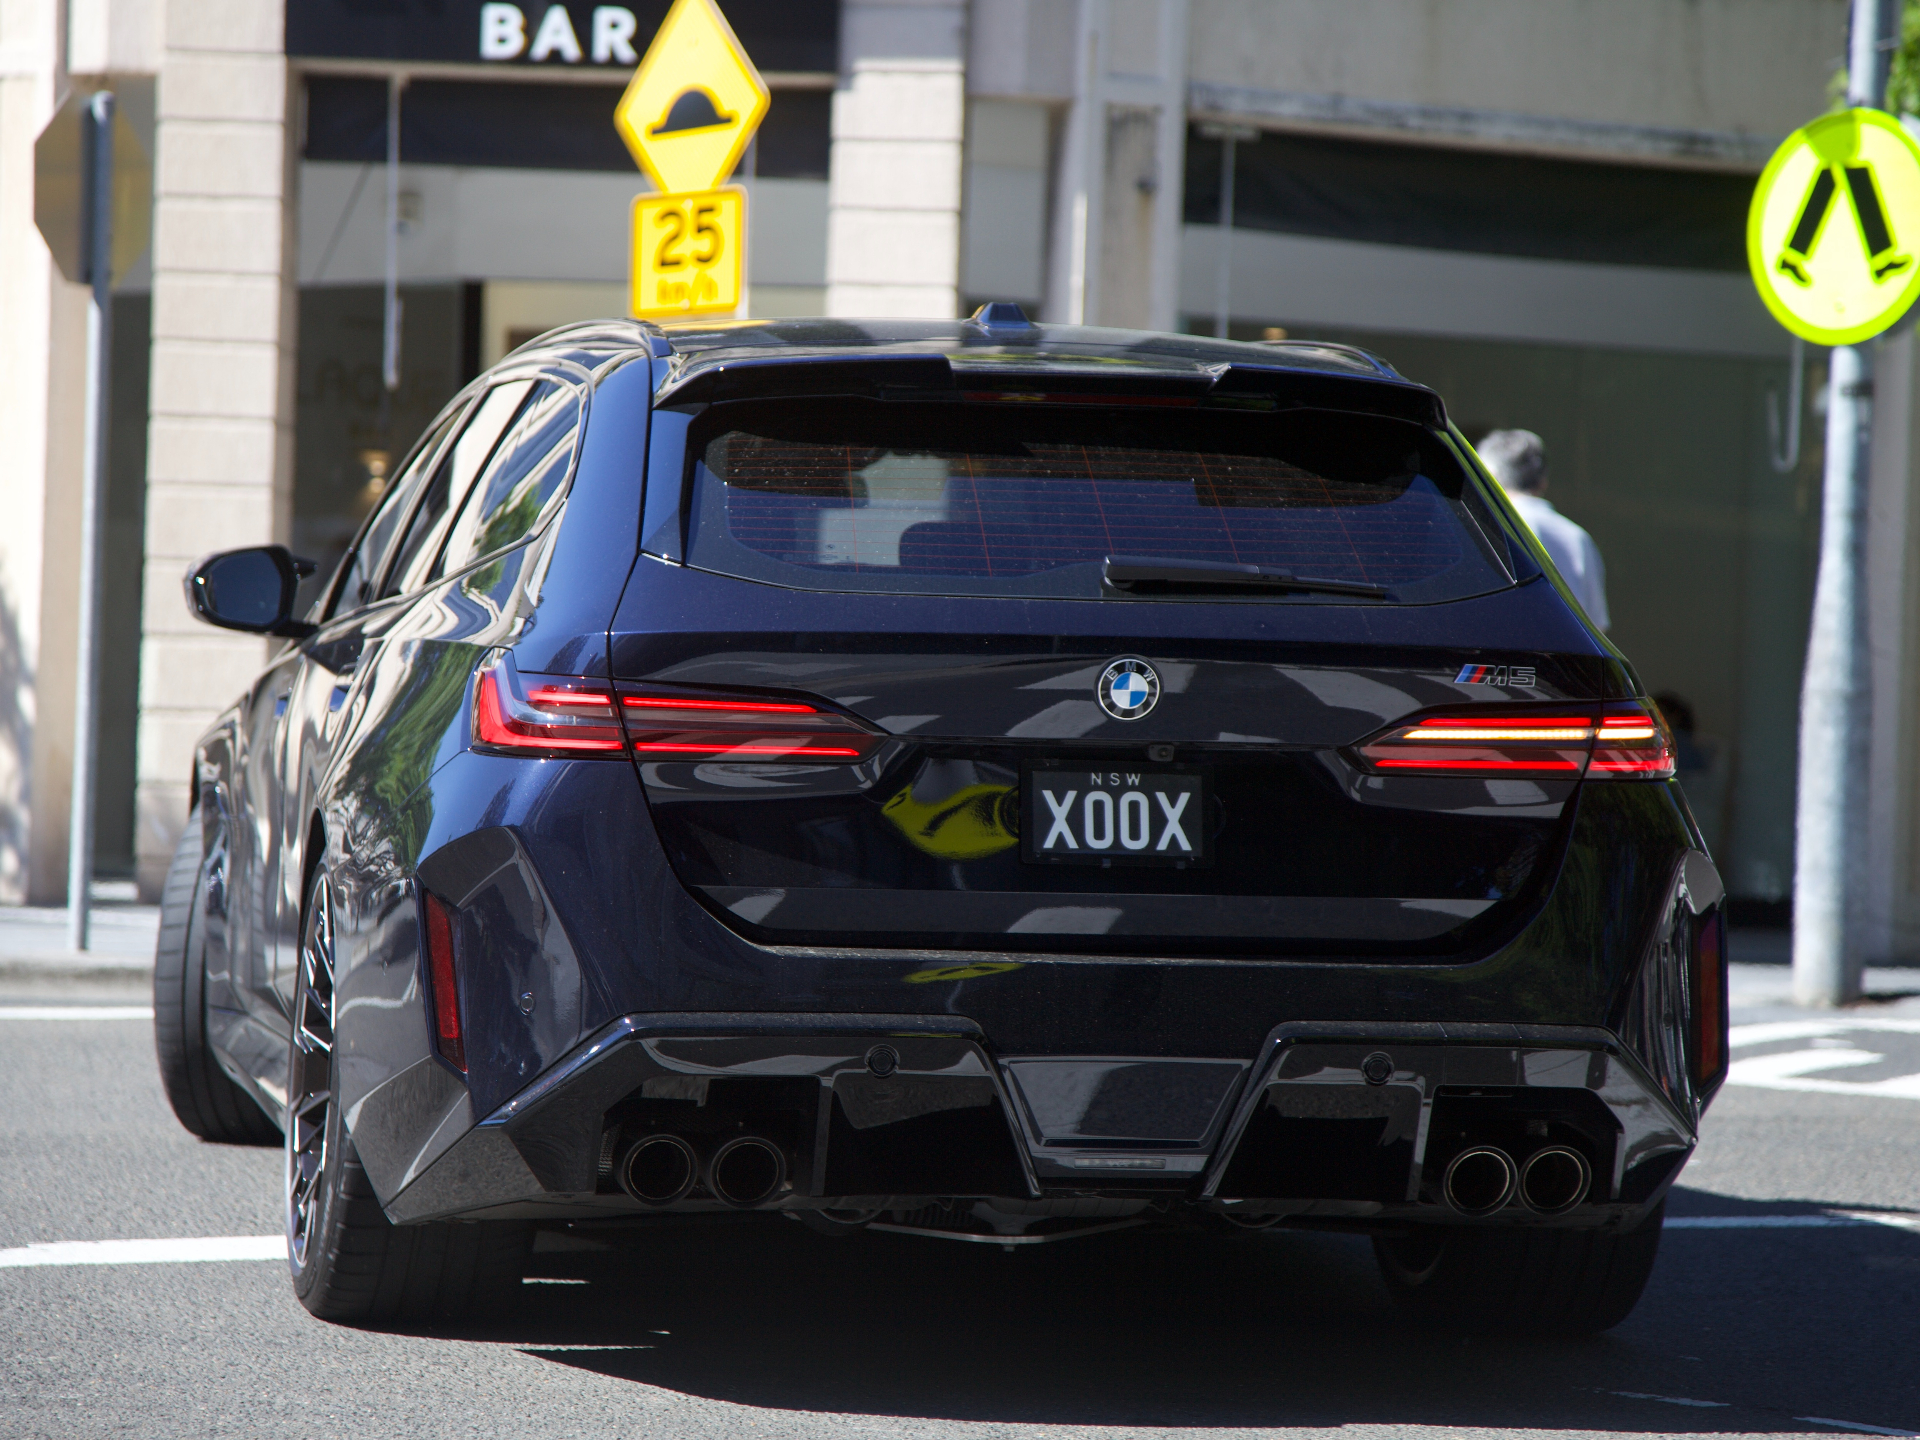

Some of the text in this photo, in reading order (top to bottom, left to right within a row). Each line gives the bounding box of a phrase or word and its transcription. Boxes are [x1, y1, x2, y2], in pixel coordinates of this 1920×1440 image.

[480, 2, 638, 63] BAR
[656, 205, 723, 271] 25
[1106, 661, 1155, 682] BMW
[1475, 664, 1536, 687] M5
[1091, 772, 1141, 786] NSW
